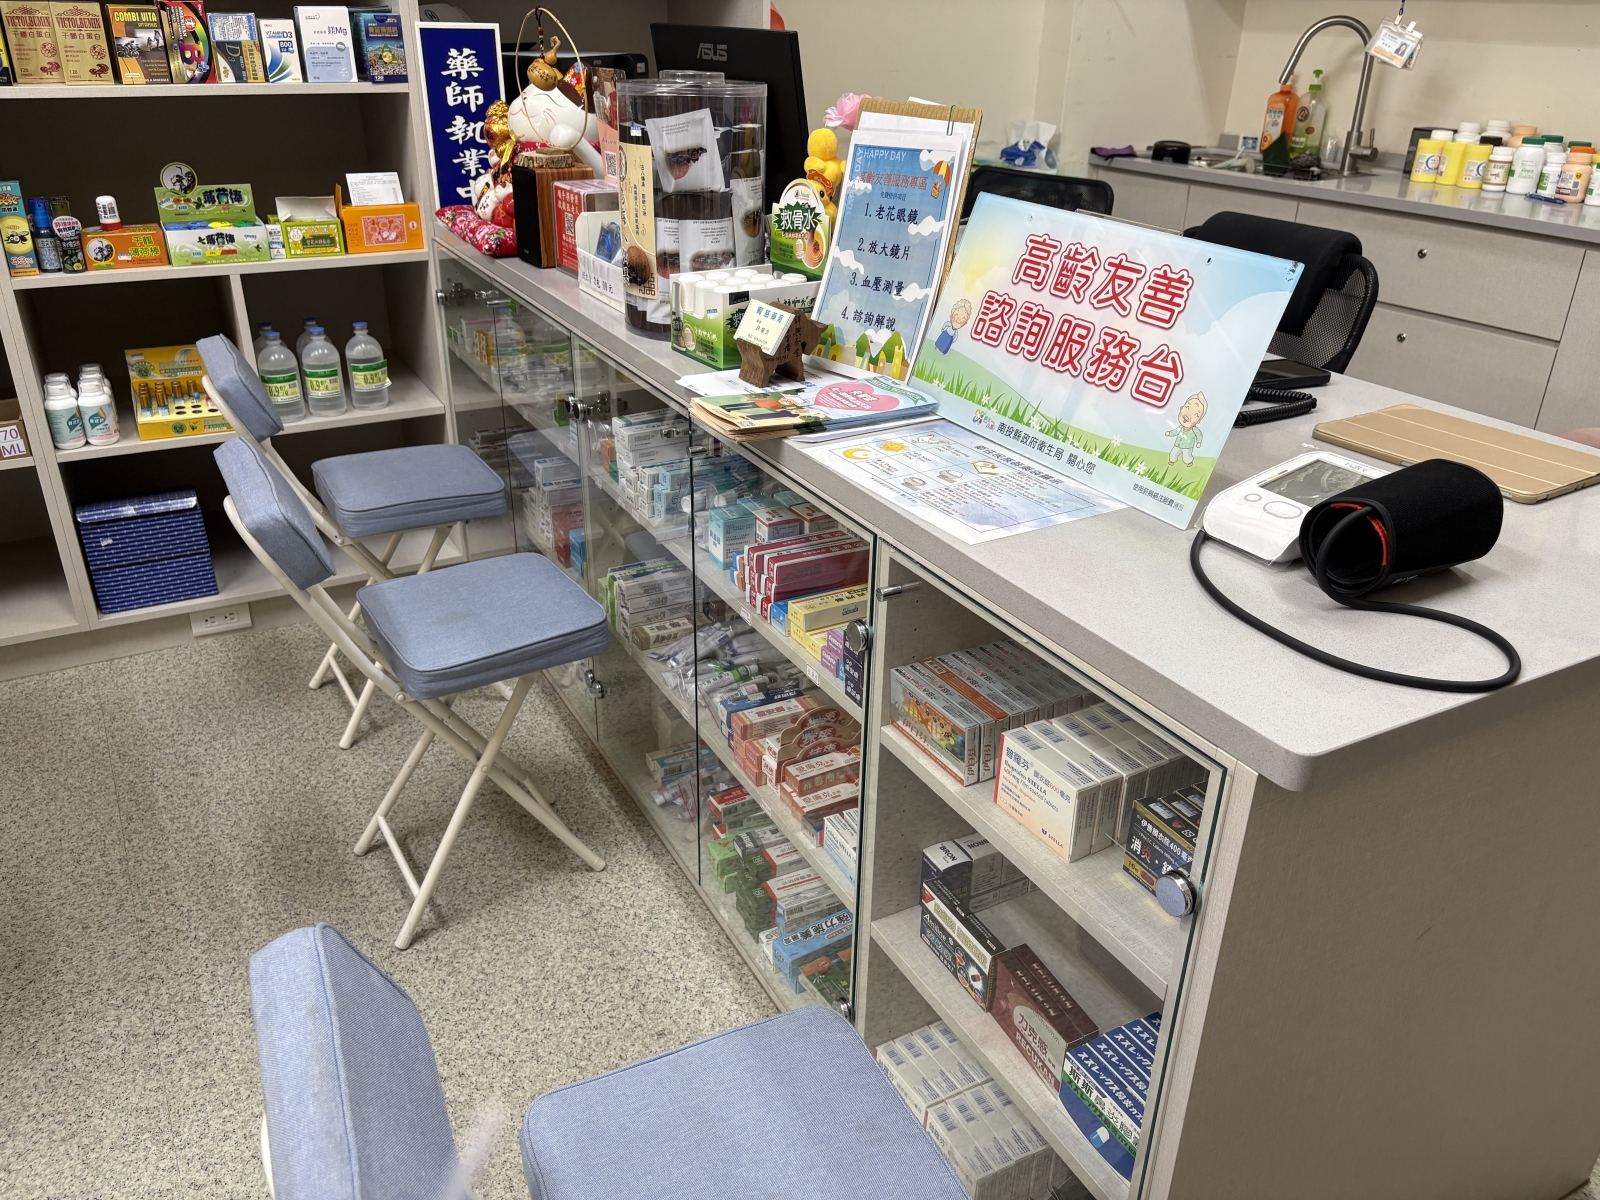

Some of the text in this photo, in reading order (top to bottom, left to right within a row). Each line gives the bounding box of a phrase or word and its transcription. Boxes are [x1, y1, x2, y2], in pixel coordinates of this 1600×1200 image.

[5, 16, 51, 28] VICTOLBUMIN
[55, 17, 101, 29] VICTOLBUMIN
[114, 11, 157, 22] COMBI VITA
[282, 31, 293, 39] D3
[696, 42, 728, 62] ASUS
[863, 149, 907, 162] HAPPY DAY
[857, 170, 929, 191] 高齡友善服務專區
[202, 187, 243, 206] 薄荷棒
[780, 208, 816, 231] 救骨水
[864, 202, 919, 225] 1. 老花眼鏡
[205, 232, 236, 246] 薄荷棒
[129, 247, 160, 258] 薄荷棒
[857, 237, 911, 261] 2. 放大鏡片
[850, 271, 905, 297] 3. 血壓測量
[1012, 233, 1194, 330] 高齡友善
[841, 305, 897, 332] 4. 諮詢解說
[971, 290, 1185, 409] 諮詢服務台
[309, 379, 329, 391] 0.9%
[363, 372, 382, 385] 0.9%
[268, 385, 289, 397] 0.9%
[1, 443, 27, 457] ML
[996, 422, 1065, 461] 南投縣政府衛生局
[1066, 452, 1097, 475] 關心您
[1004, 759, 1047, 796] Ibuprofen STELLA
[1048, 833, 1064, 849] STELLA
[939, 844, 958, 862] BRON
[1016, 1030, 1056, 1089] RECUKAN
